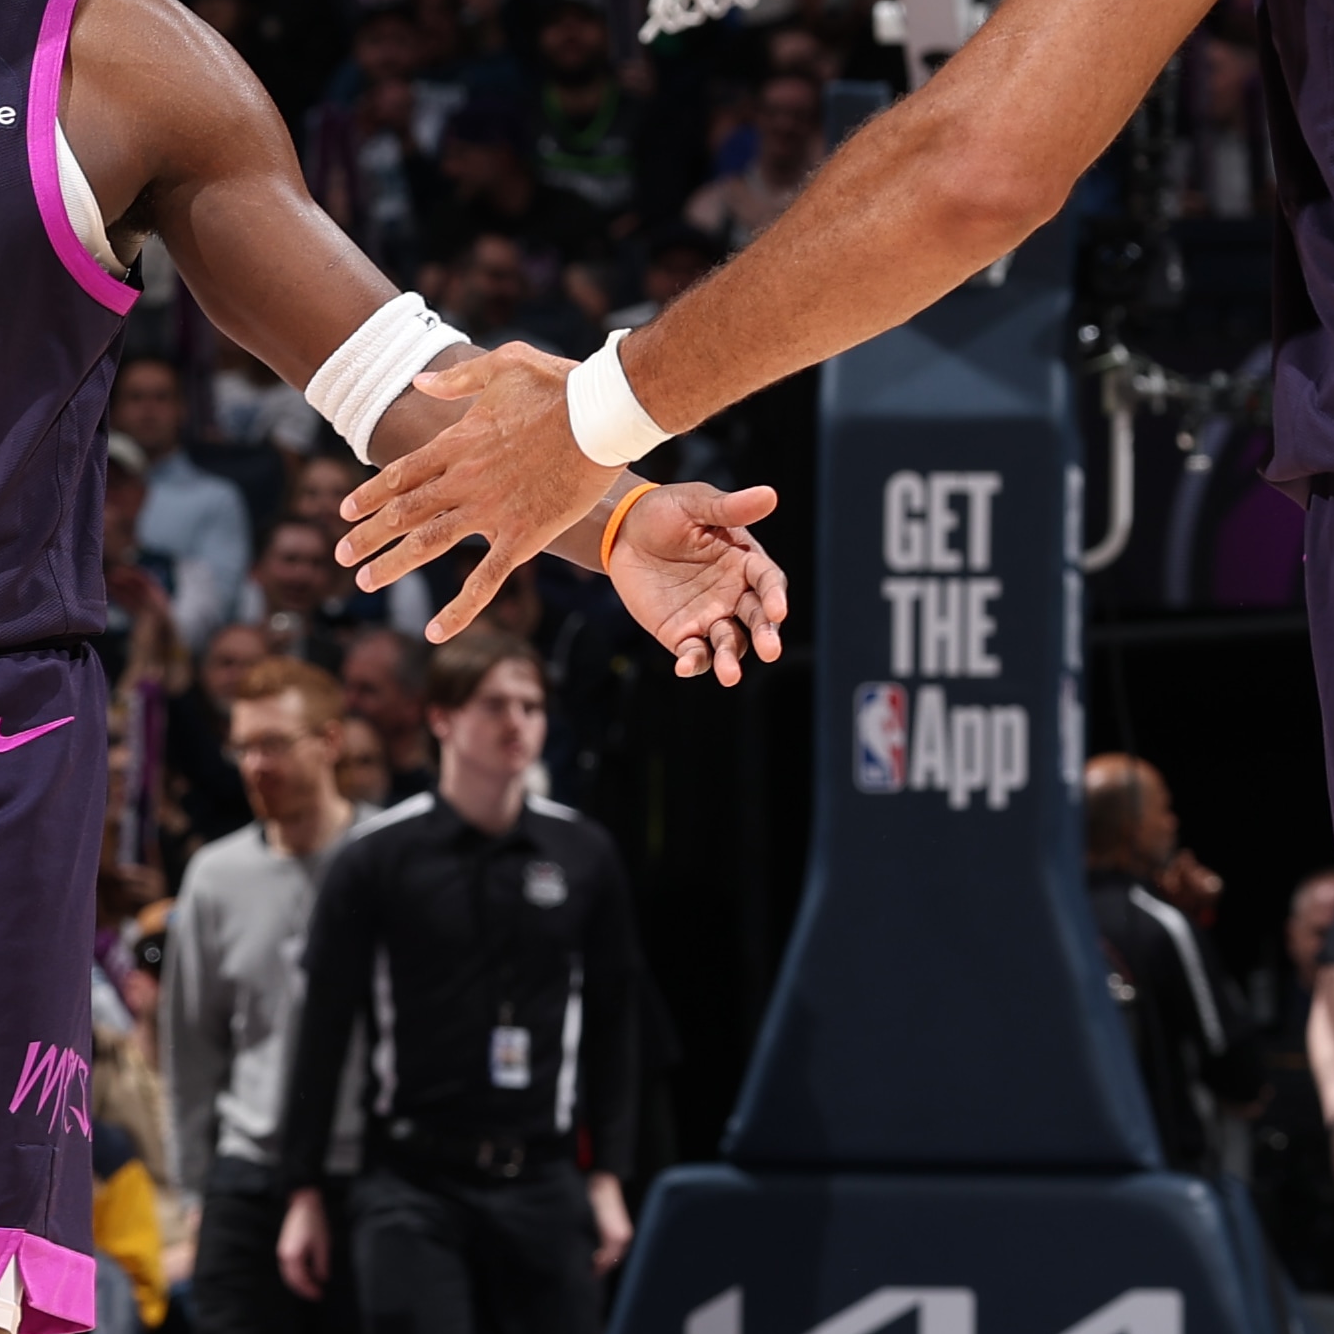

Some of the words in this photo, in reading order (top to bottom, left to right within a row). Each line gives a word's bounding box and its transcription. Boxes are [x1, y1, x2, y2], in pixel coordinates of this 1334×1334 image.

[882, 470, 1003, 574] GET
[881, 577, 1003, 679] THE
[909, 685, 1030, 811] App
